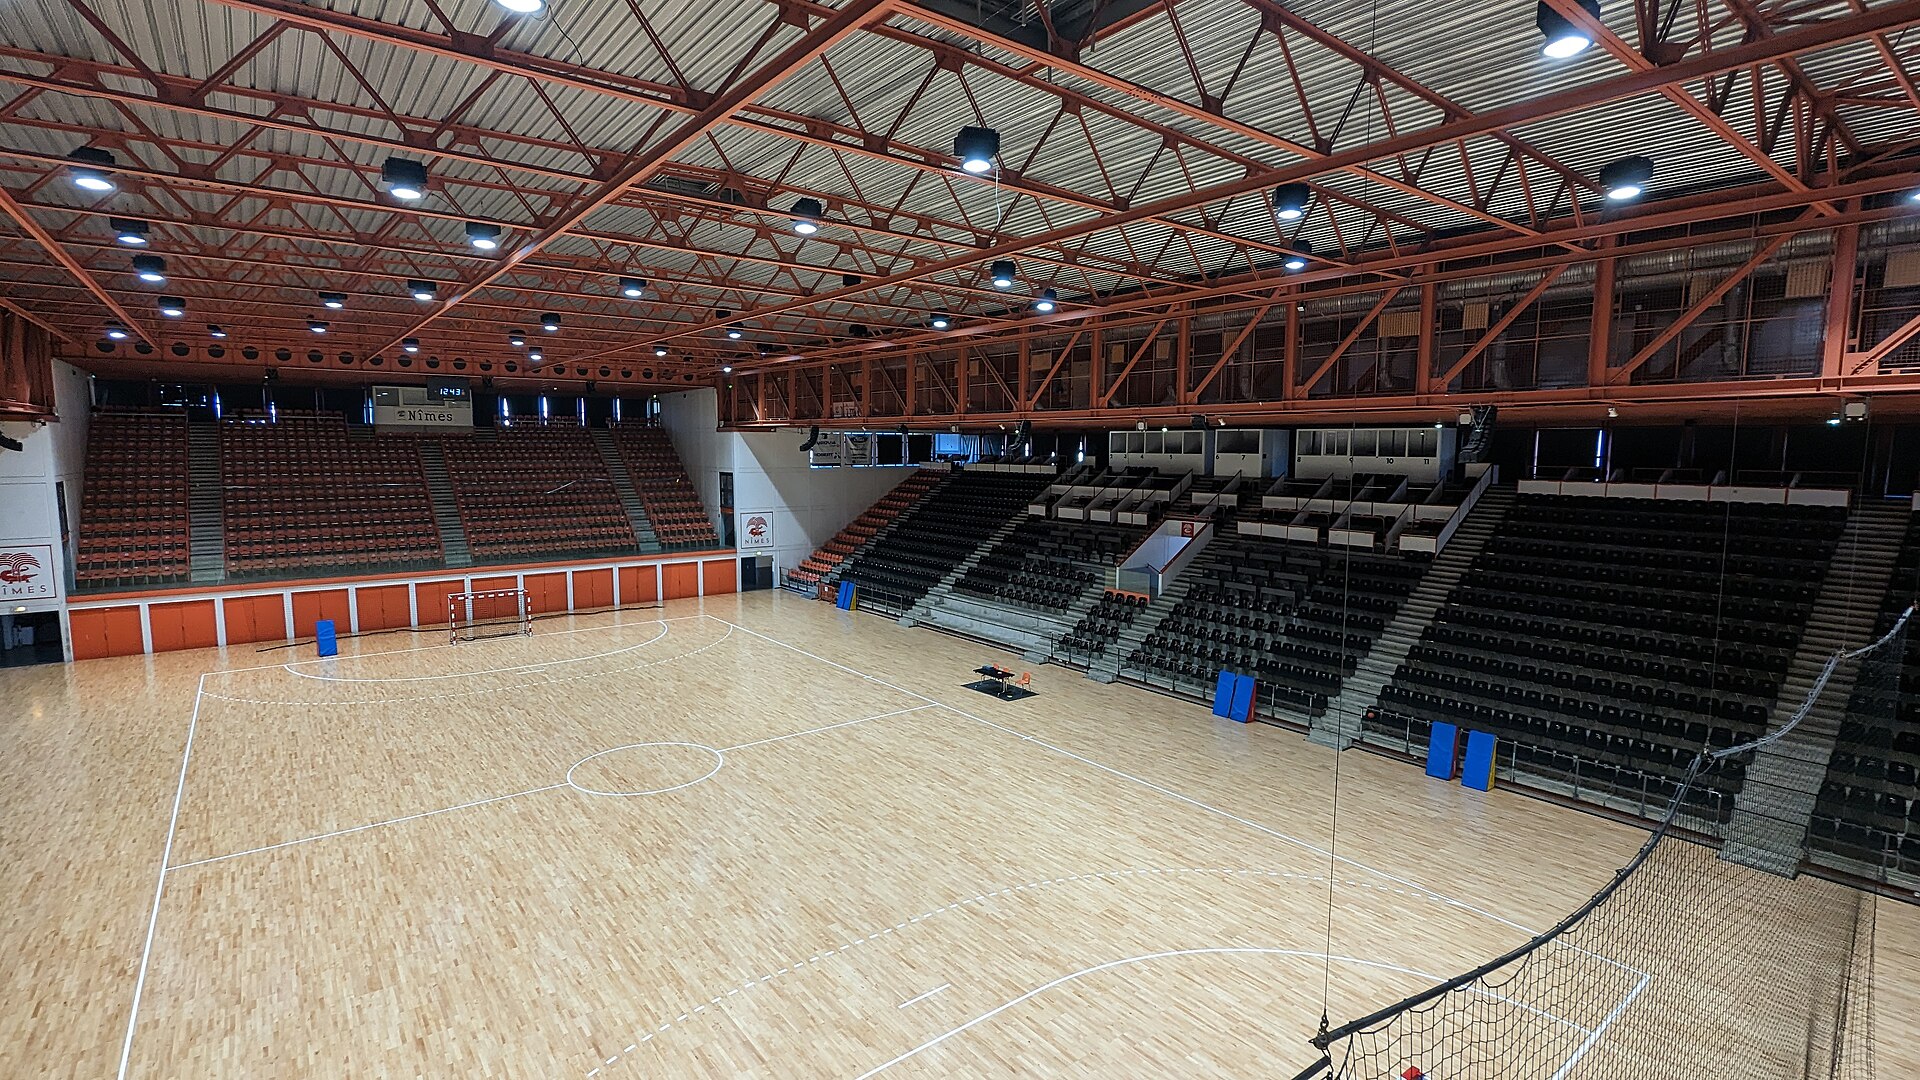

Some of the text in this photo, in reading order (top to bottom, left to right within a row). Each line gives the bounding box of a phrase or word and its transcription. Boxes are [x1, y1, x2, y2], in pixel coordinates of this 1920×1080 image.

[408, 409, 453, 421] Nîmes
[745, 537, 770, 545] NÎMES
[1, 584, 47, 595] ÎMES
